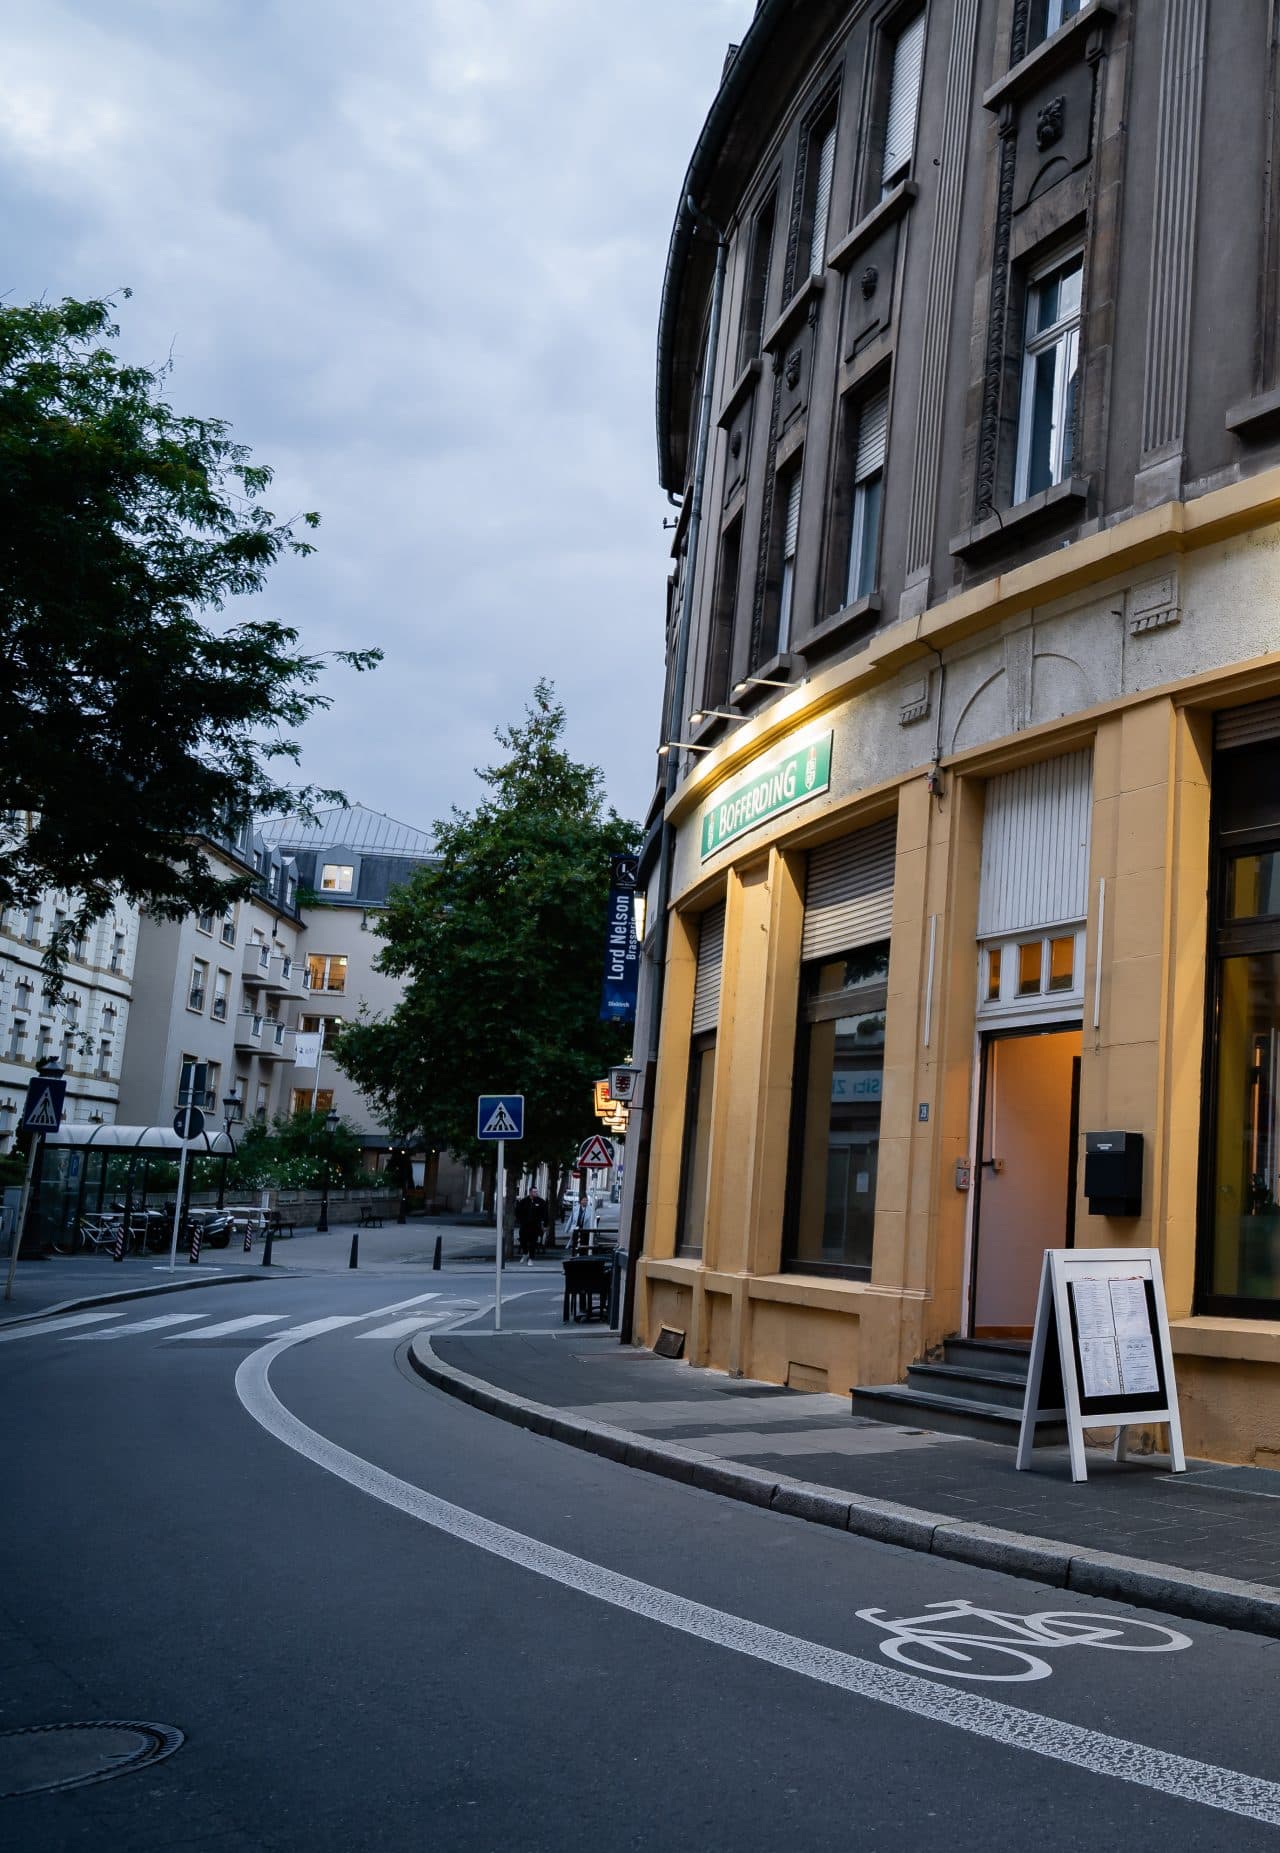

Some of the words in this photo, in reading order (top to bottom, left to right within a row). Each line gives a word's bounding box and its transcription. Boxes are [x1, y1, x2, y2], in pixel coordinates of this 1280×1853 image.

[719, 760, 797, 840] BOFFERDING
[609, 895, 630, 944] Nelson
[607, 949, 626, 980] Lord
